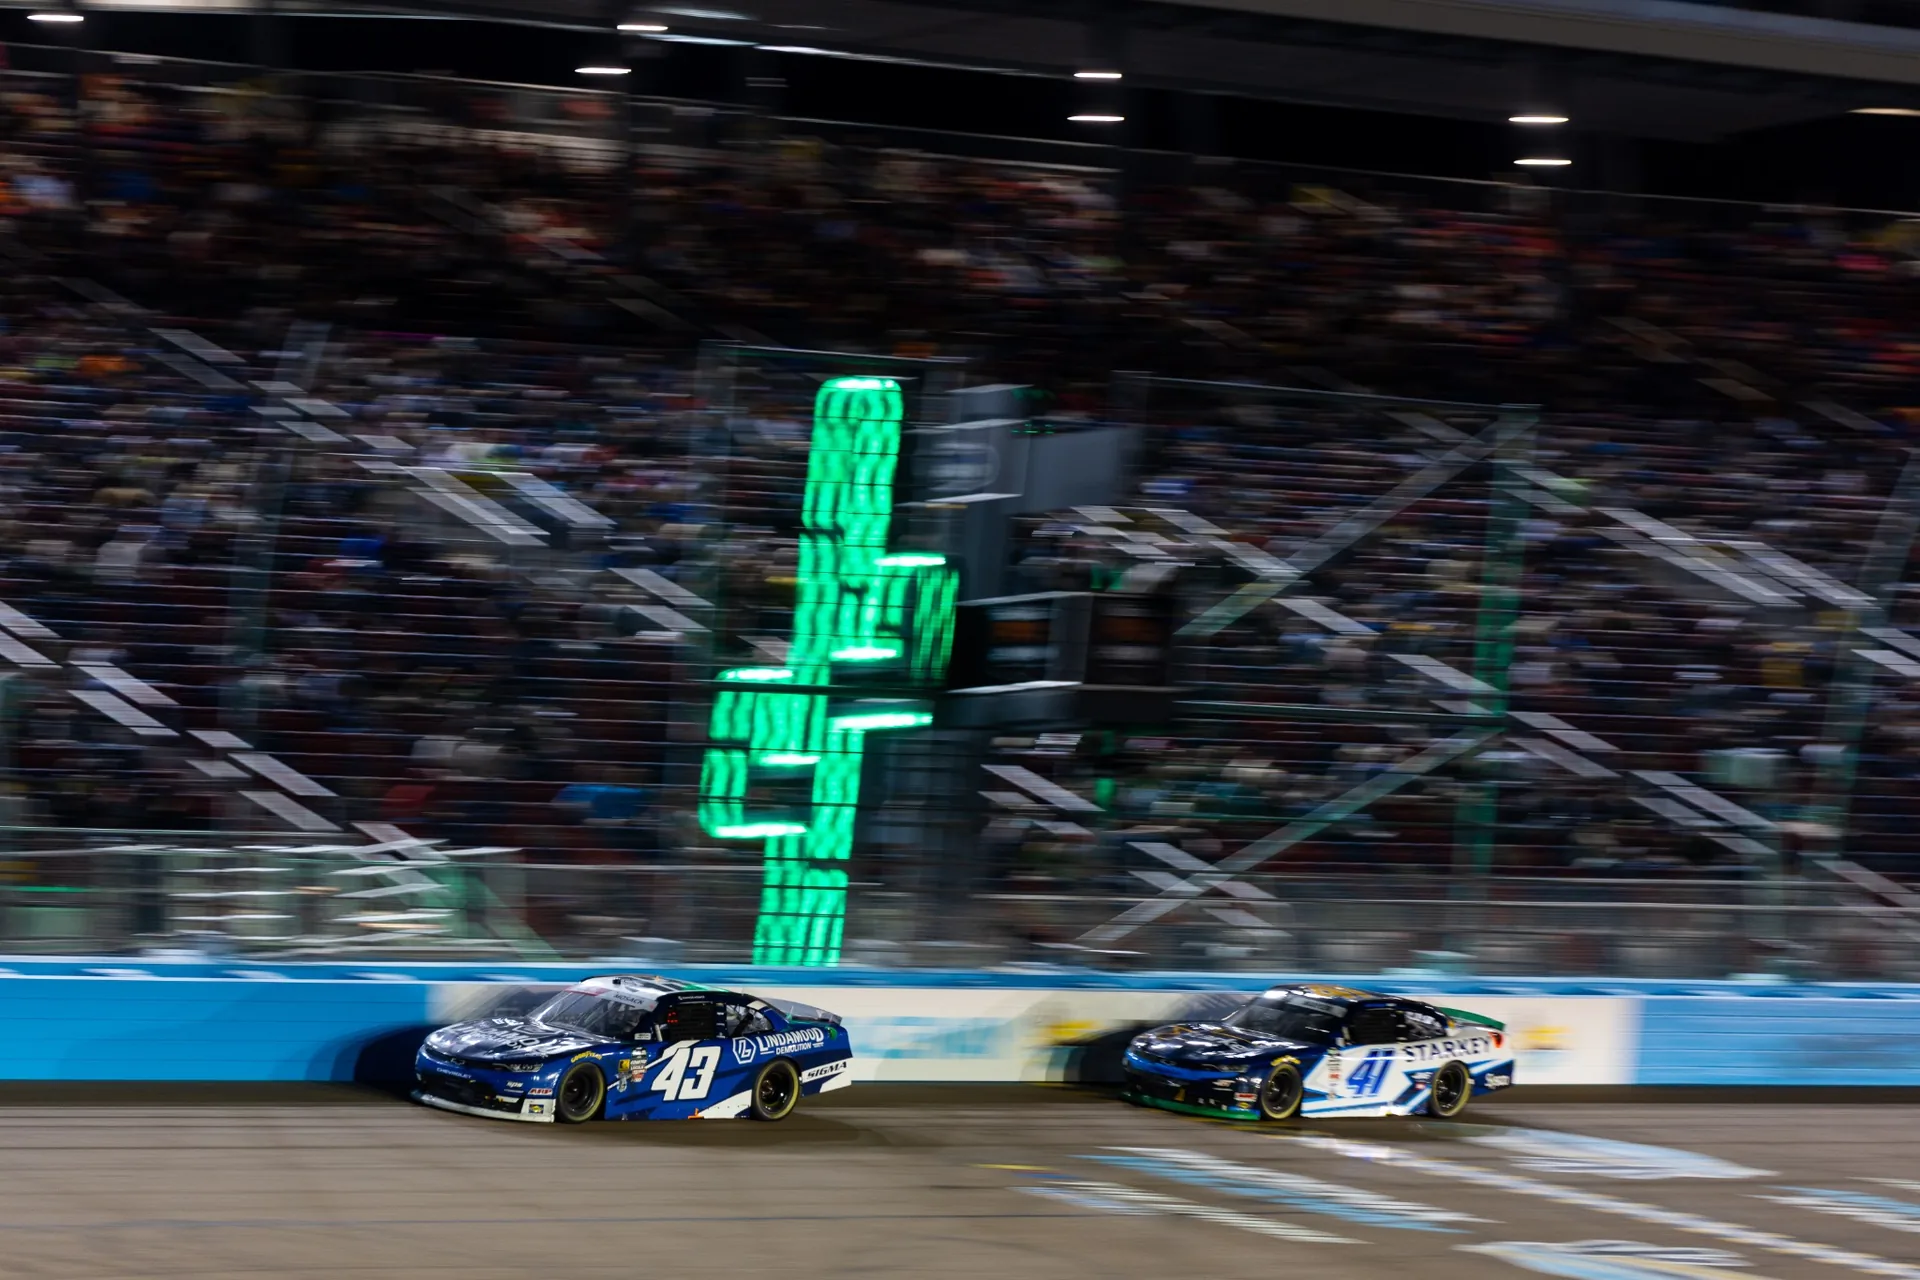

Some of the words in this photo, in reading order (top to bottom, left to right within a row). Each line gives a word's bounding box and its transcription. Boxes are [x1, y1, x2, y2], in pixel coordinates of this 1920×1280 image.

[755, 1027, 824, 1051] LINDAMOOD
[776, 1042, 812, 1055] DEMOLITION
[1402, 1037, 1491, 1062] STARKEY
[437, 1067, 472, 1079] CHEVROLET
[651, 1046, 721, 1101] 43
[807, 1061, 847, 1079] SIGMA
[1346, 1047, 1395, 1098] 41
